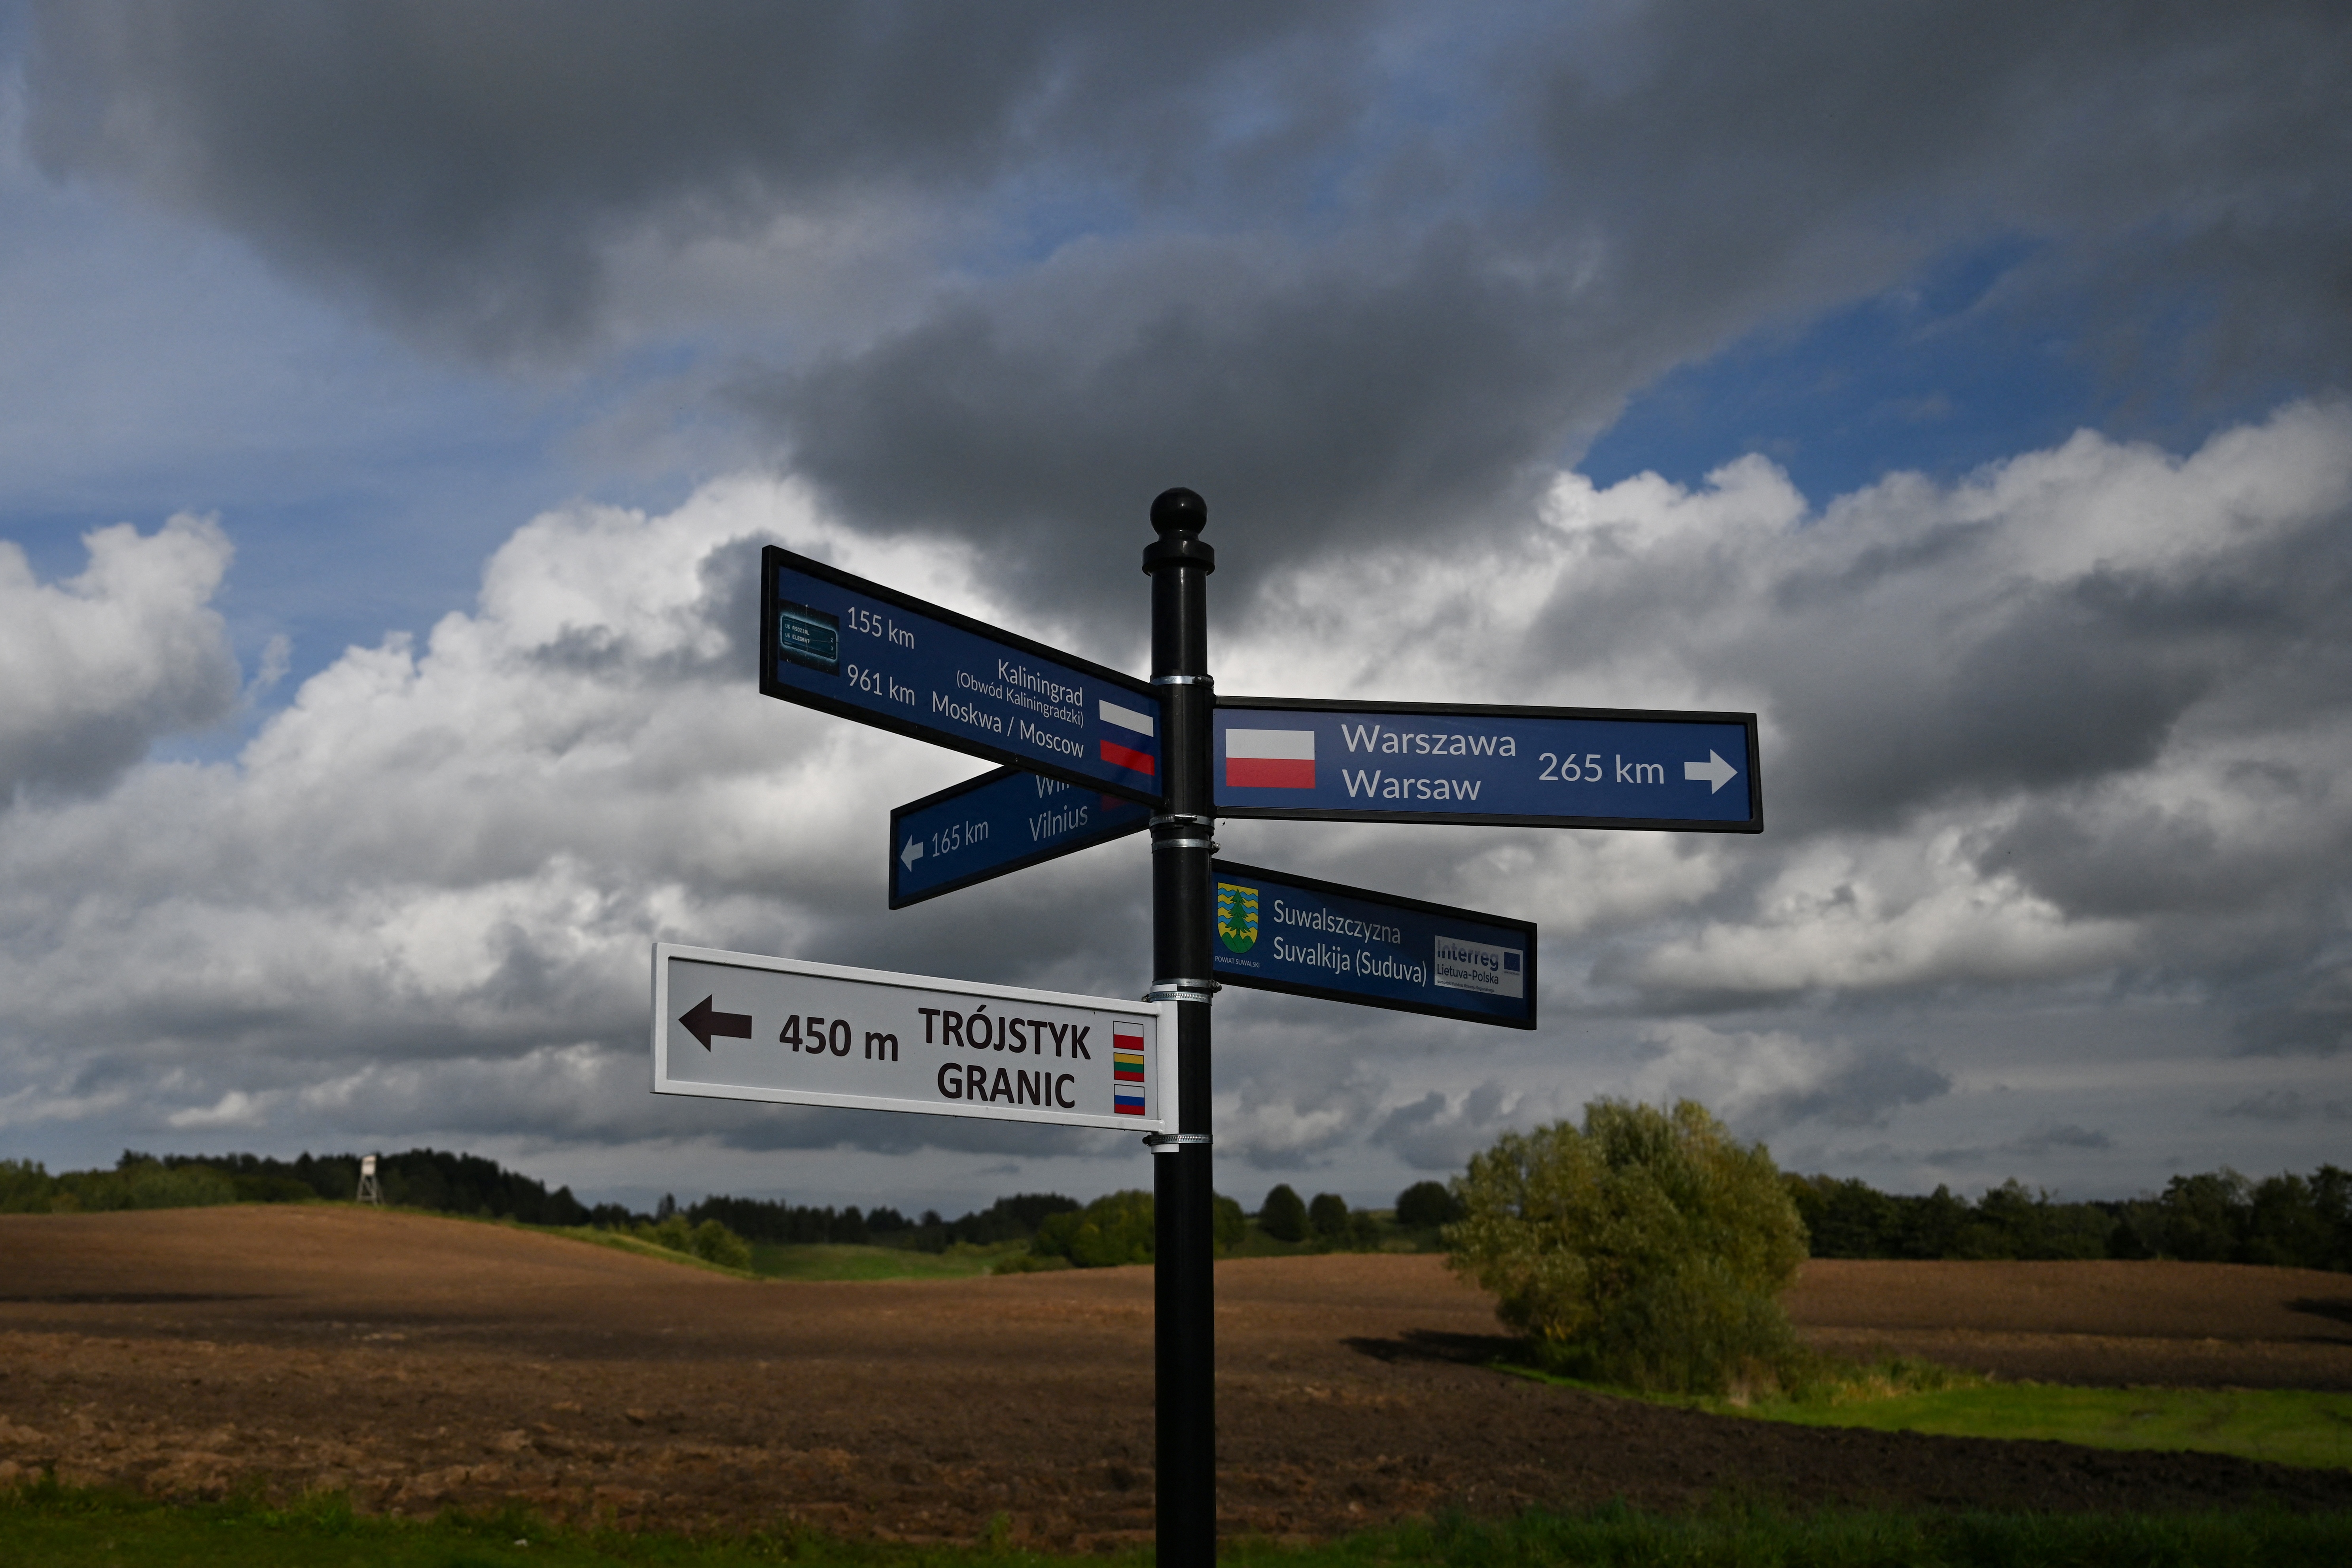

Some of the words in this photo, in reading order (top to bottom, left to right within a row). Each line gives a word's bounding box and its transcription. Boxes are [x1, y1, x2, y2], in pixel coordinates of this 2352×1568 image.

[848, 607, 882, 637] 155
[889, 619, 914, 649] km
[848, 664, 882, 696] 961
[889, 676, 915, 706] km
[957, 670, 1002, 700] (Obwód
[1007, 687, 1083, 728] Kaliningradzki)
[999, 659, 1082, 707] Kaliningrad
[933, 691, 1001, 733] Moskwa
[1007, 716, 1014, 737] /
[1020, 719, 1084, 758] Moscow
[1341, 724, 1516, 757] Warszawa
[1342, 769, 1481, 800] Warsaw
[1539, 752, 1602, 782] 265
[1616, 754, 1664, 784] km
[932, 825, 960, 857] 165
[966, 821, 988, 845] km
[1029, 804, 1088, 841] Vilnius
[1273, 900, 1400, 944] Suwalszczyzna
[1215, 955, 1235, 964] POWIAT
[1236, 959, 1260, 968] SUWALSKI
[1273, 936, 1350, 974] Suvalkija
[1356, 949, 1426, 987] (Suduva)
[1437, 939, 1499, 972] Interreg
[1437, 964, 1499, 984] Lietuva-Polska
[779, 1014, 851, 1057] 450
[865, 1032, 898, 1062] m
[918, 1004, 1091, 1060] TRÓJSTYK
[937, 1062, 1075, 1108] GRANIC
